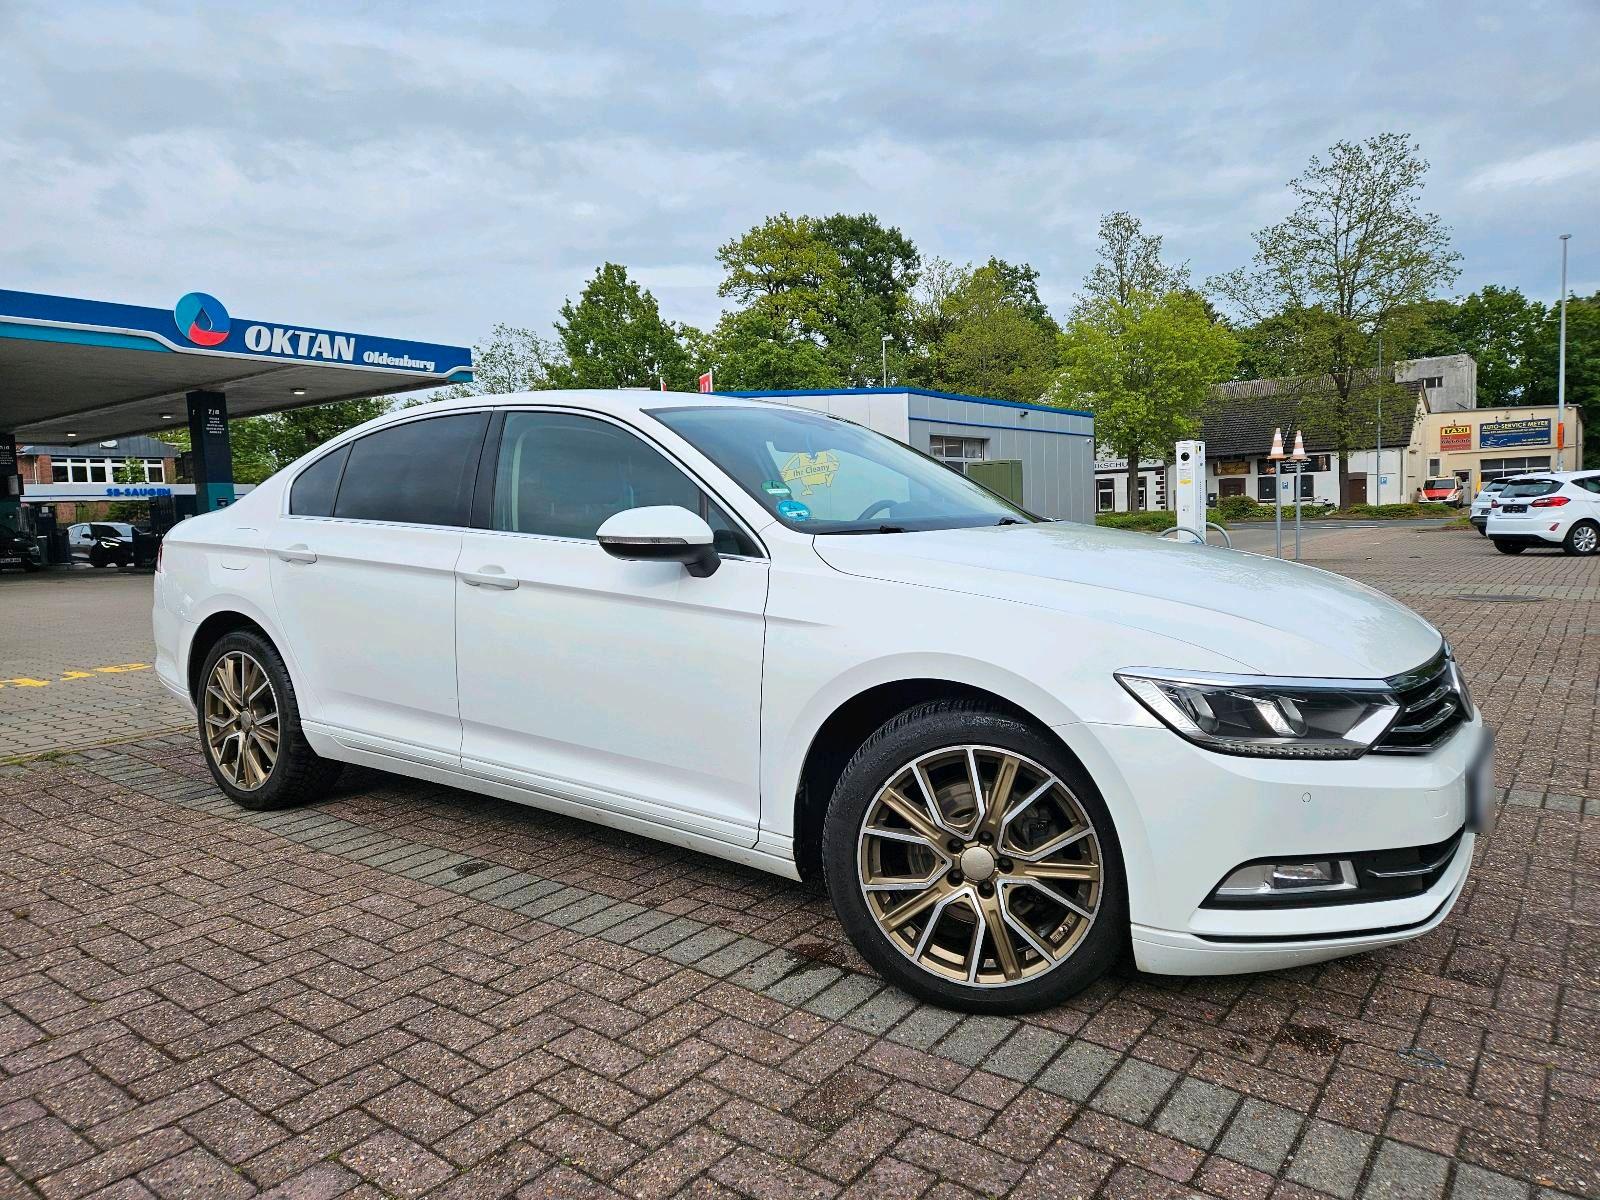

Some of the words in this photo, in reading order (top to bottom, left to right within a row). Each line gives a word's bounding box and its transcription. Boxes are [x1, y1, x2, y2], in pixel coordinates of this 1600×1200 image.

[244, 325, 356, 361] OKTAN
[362, 350, 436, 372] Oldenburg
[1482, 421, 1526, 430] AUTO-SERVICE
[805, 464, 830, 474] Cleany
[106, 488, 171, 497] SB-SAUGEN
